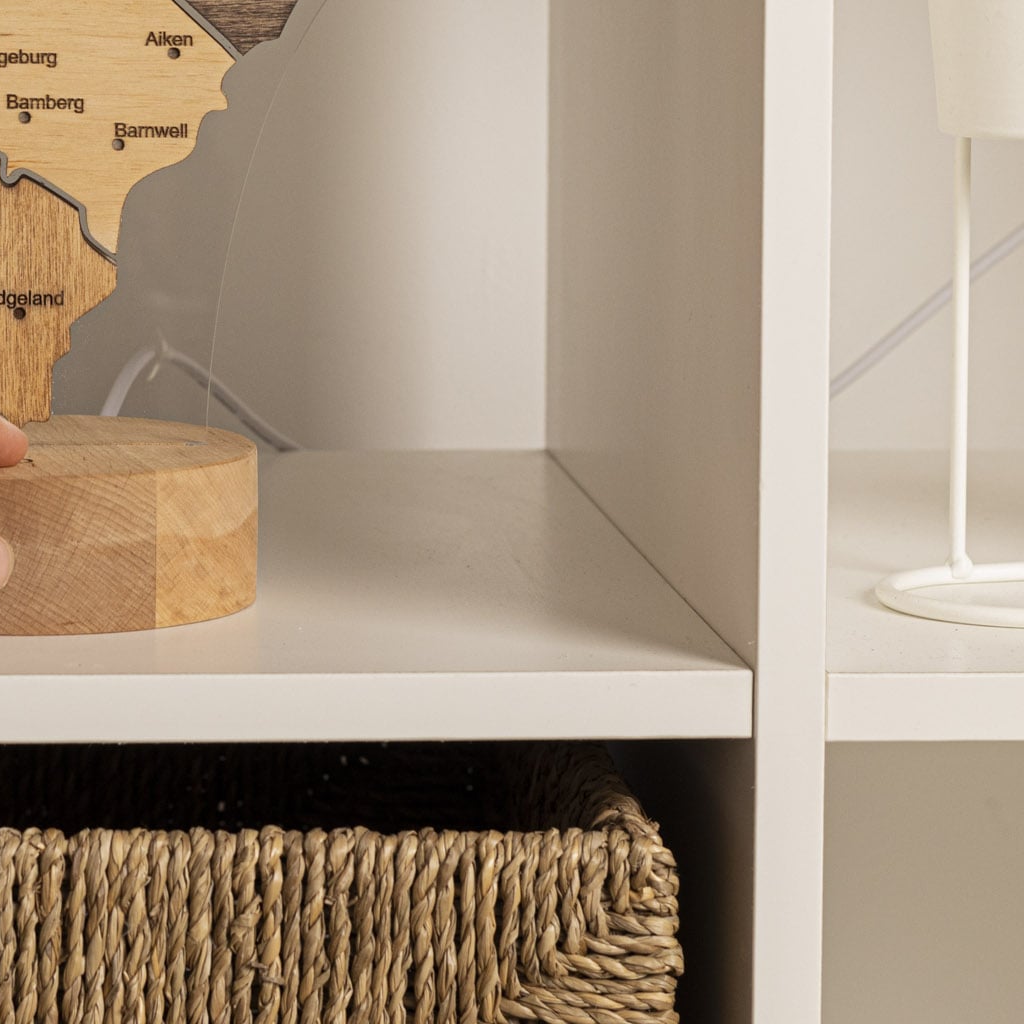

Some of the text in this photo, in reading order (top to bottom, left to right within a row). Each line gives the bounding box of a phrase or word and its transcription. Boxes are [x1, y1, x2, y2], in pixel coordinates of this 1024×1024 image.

[145, 32, 193, 47] Aiken
[6, 95, 84, 114] Bamberg
[114, 123, 188, 139] Barnwell
